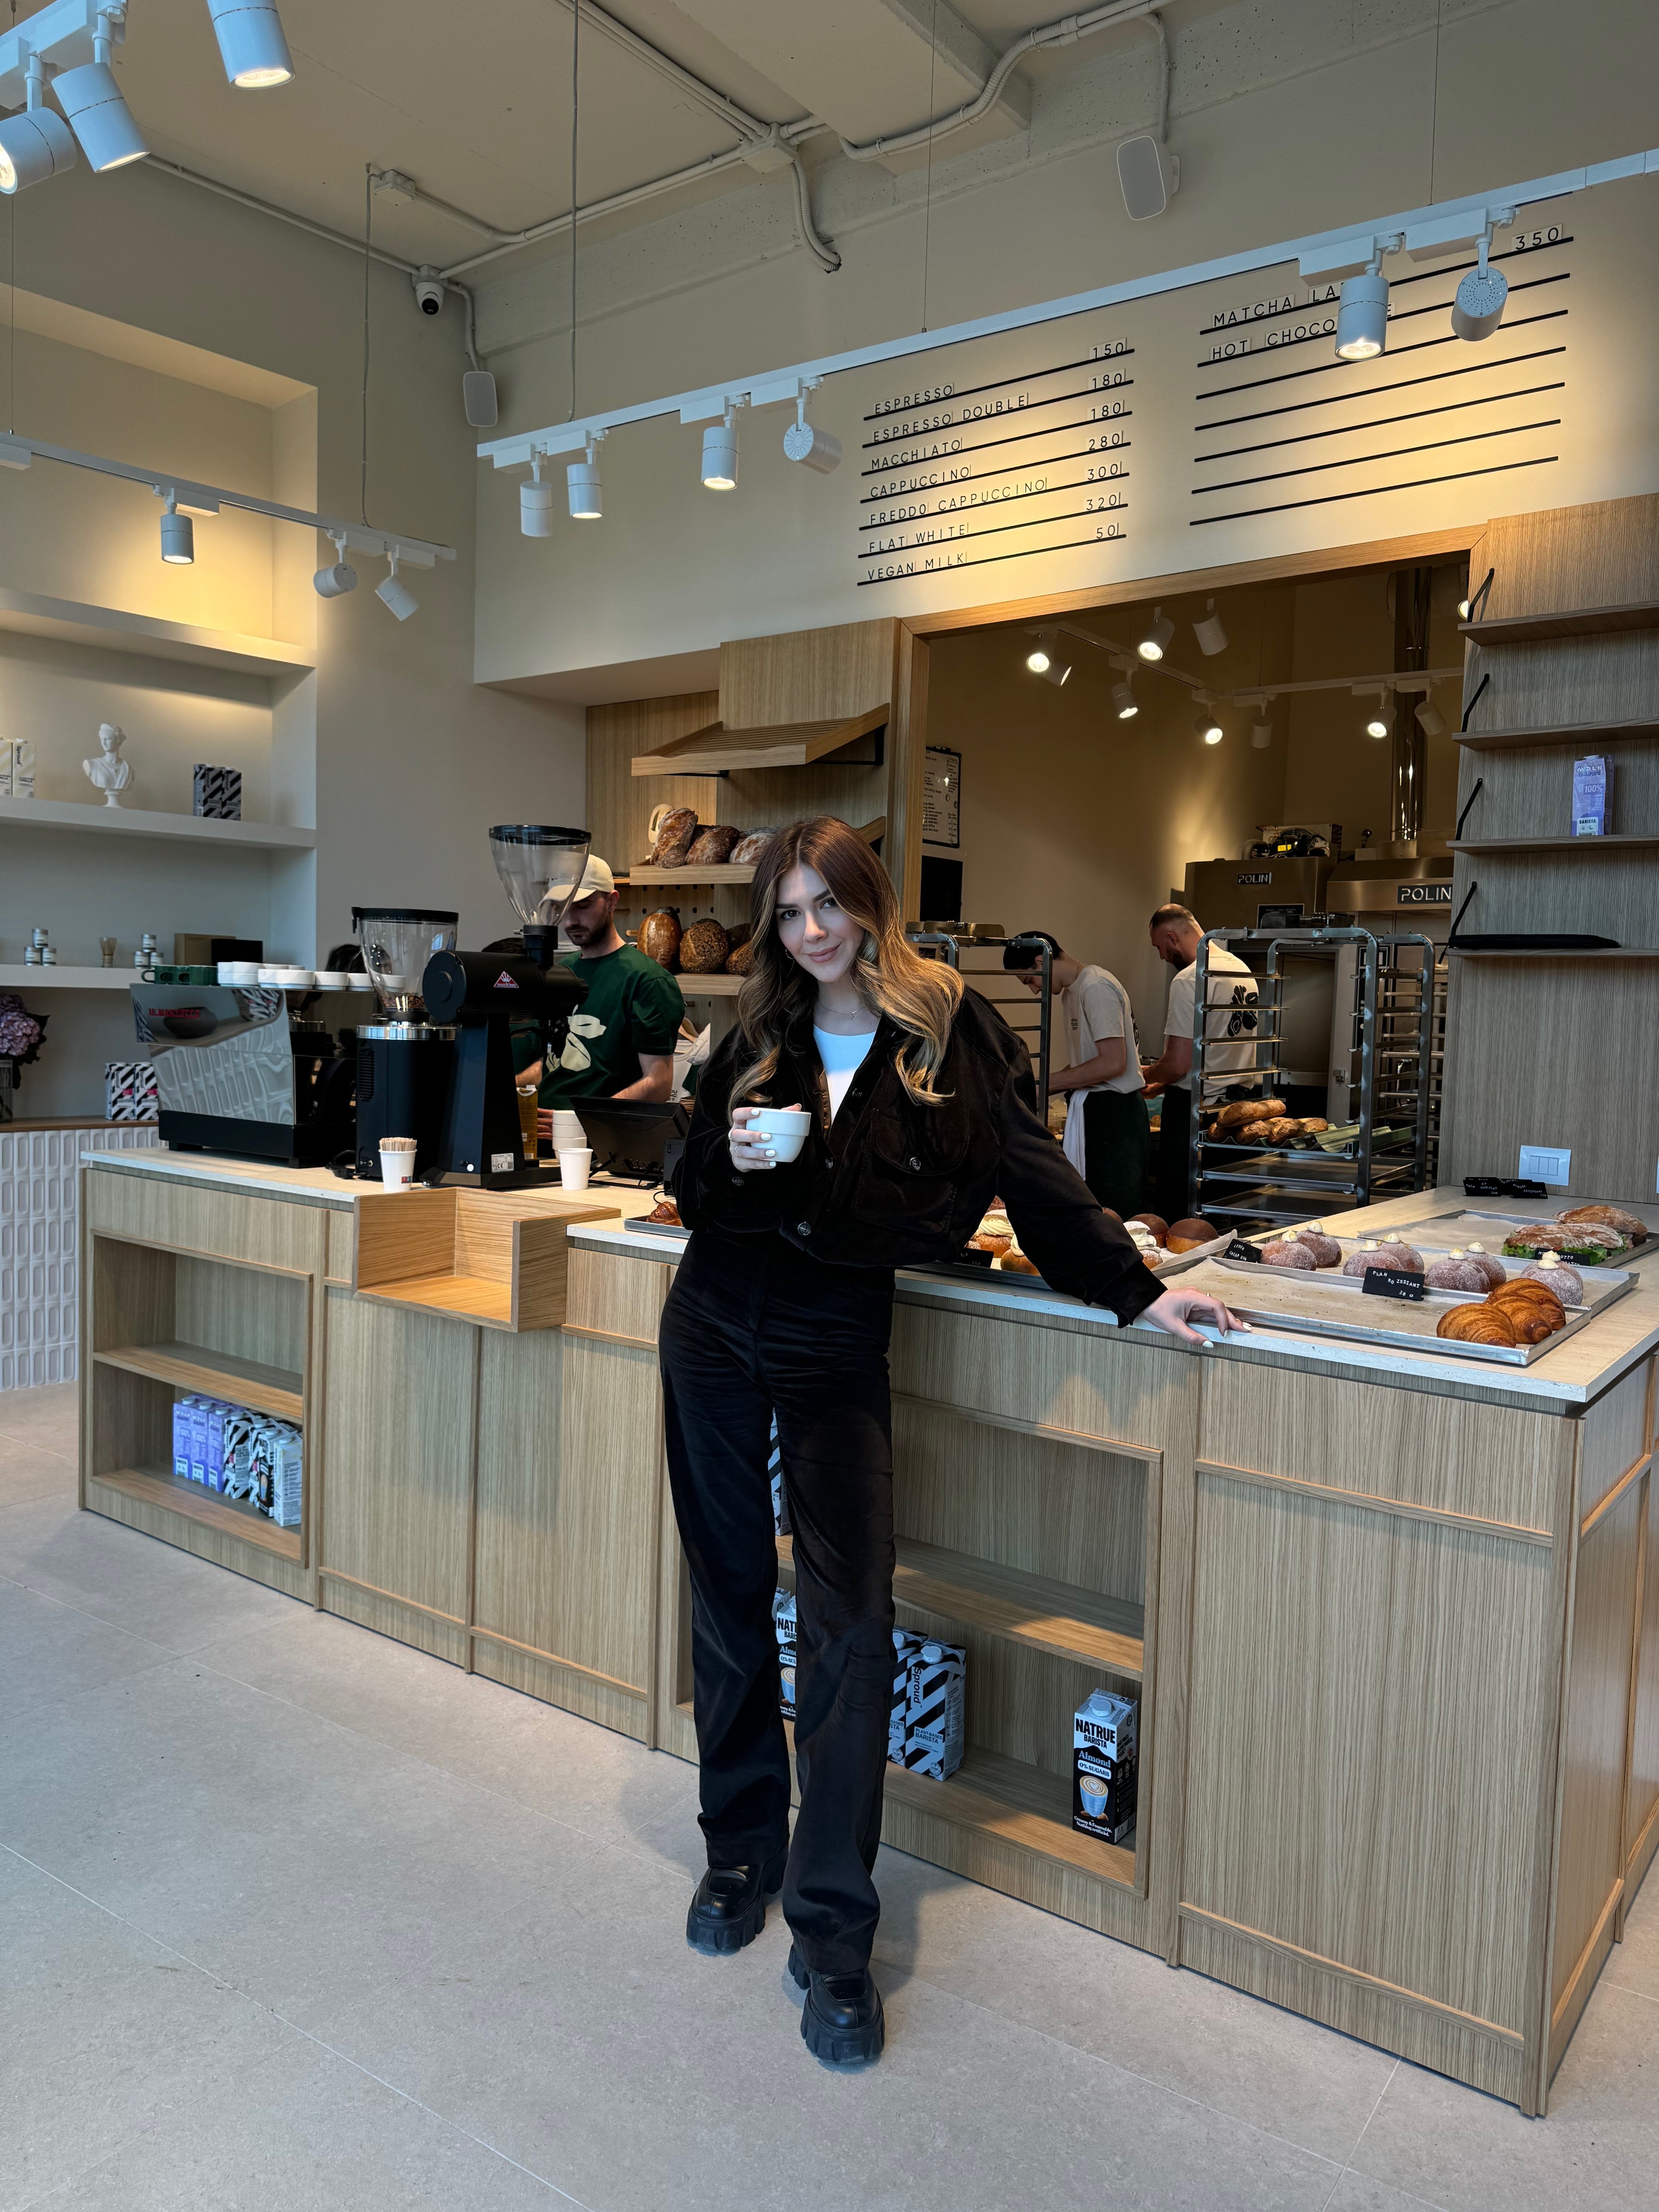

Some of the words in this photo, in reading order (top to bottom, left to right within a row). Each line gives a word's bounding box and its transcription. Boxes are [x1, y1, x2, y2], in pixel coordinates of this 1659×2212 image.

[1516, 228, 1559, 251] 350
[1213, 296, 1291, 327] MATCHA
[1093, 342, 1124, 359] 150
[1212, 340, 1249, 360] HOT
[1092, 373, 1122, 390] 180
[875, 385, 952, 414] ESPRESSO
[873, 414, 951, 442] ESPRESSO
[963, 395, 1025, 421] DOUBLE
[1091, 402, 1121, 420] 180
[1089, 433, 1120, 451] 280
[871, 439, 960, 470] MACCHIATO
[1087, 464, 1118, 481] 300
[870, 467, 969, 498] CAPPUCCINO
[870, 504, 926, 525] FREDDO
[938, 479, 1045, 511] CAPPUCCINO
[1086, 494, 1117, 511] 320
[869, 536, 905, 553] FLAT
[916, 524, 965, 543] WHITE
[1096, 527, 1115, 539] 50
[868, 562, 914, 580] VEGAN
[925, 553, 964, 570] MILK
[1584, 785, 1602, 793] 100%
[1238, 874, 1268, 884] POLIN
[1401, 887, 1451, 901] POLIN
[778, 1617, 797, 1632] NAT
[912, 1667, 922, 1704] Sproud
[915, 1732, 938, 1744] BARISTA
[1076, 1718, 1115, 1744] NATRUE
[1084, 1734, 1107, 1749] BARISTA
[1079, 1750, 1111, 1768] Almond
[1089, 1765, 1109, 1777] SUGARS
